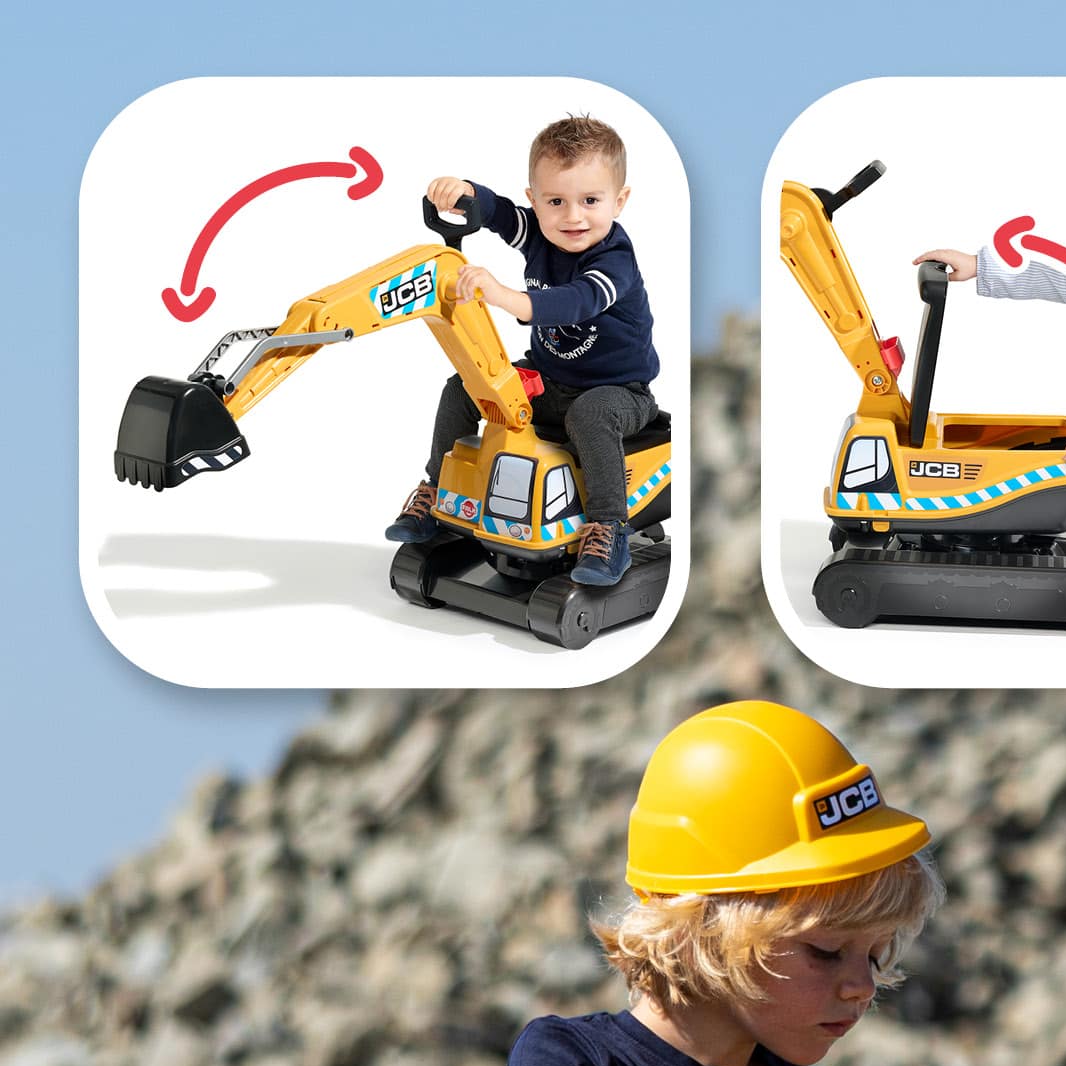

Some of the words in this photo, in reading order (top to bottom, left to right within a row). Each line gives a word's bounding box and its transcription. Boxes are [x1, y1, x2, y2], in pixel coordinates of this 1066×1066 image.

[383, 273, 433, 312] JCB
[910, 462, 960, 478] JCB
[820, 778, 879, 826] JCB
